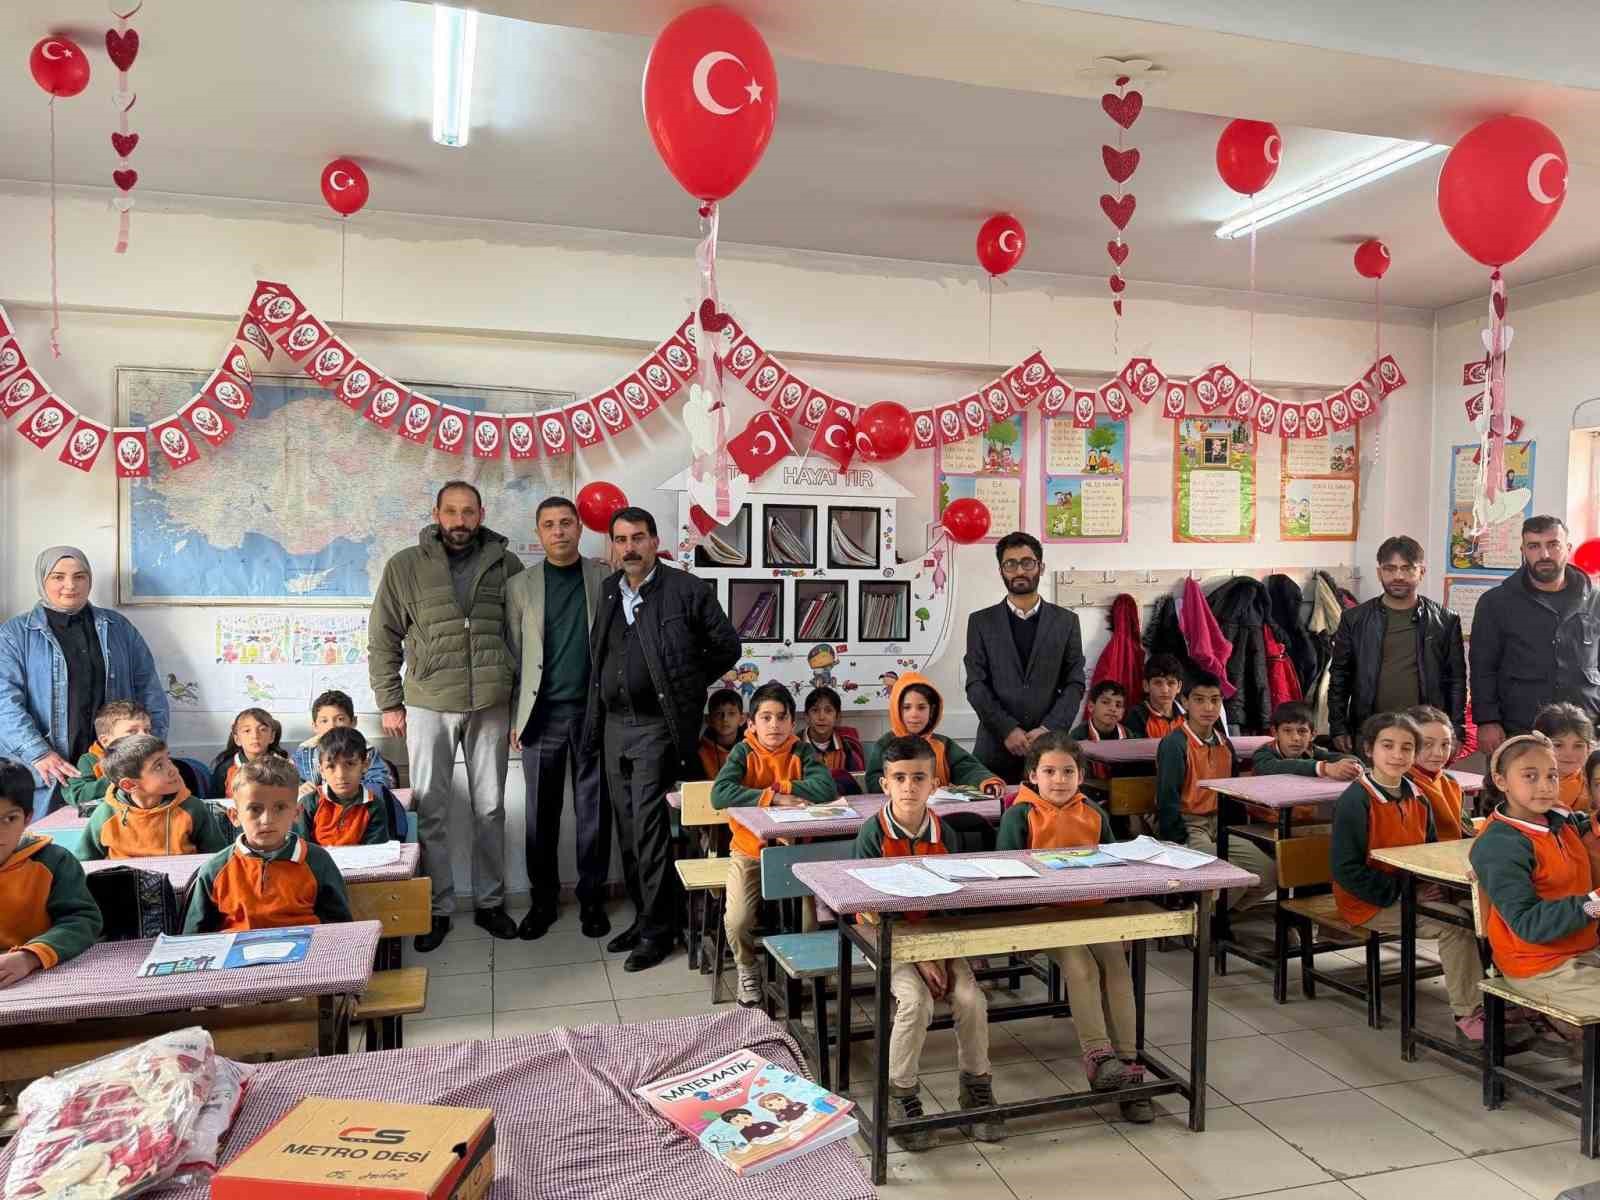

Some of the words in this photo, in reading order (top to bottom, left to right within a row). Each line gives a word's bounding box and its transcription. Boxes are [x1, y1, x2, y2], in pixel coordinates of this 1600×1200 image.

[660, 1059, 755, 1102] MATEMATİK
[283, 1143, 368, 1159] METRO
[372, 1150, 430, 1163] DESİ
